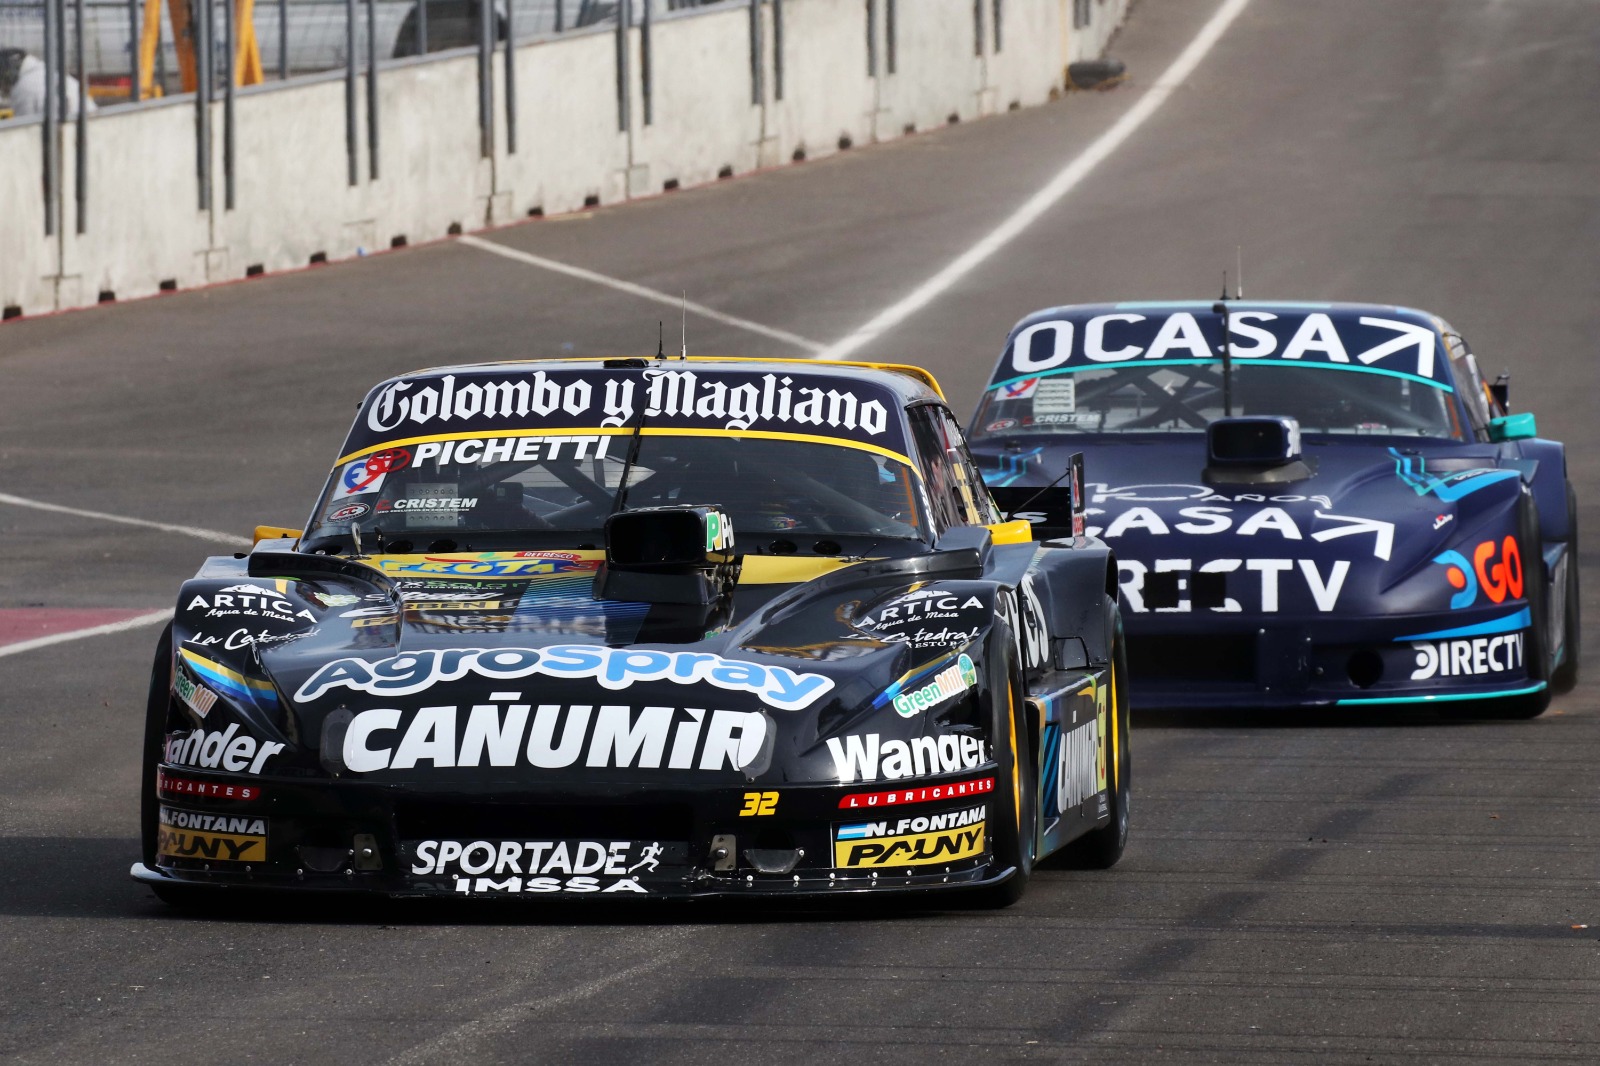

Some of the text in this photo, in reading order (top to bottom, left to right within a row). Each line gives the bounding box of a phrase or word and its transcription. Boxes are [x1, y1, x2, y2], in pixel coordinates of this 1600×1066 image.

[1011, 311, 1350, 374] OCASA
[367, 369, 888, 436] Colombo y Magliano
[411, 435, 612, 468] PICHETTI
[393, 497, 478, 509] CRISTEM
[186, 594, 318, 624] ARTICA
[205, 608, 296, 623] Agua de Mesa
[854, 595, 985, 628] ARTICA
[870, 610, 959, 632] Agua de Mesa
[183, 631, 223, 647] La
[1410, 632, 1524, 681] DIRECTV
[294, 645, 836, 711] AgroSpray
[893, 663, 968, 718] GreenMill
[739, 791, 780, 817] 32
[850, 780, 992, 807] LUBRICANTES
[865, 805, 987, 838] N.FONTANA
[411, 841, 632, 876] SPORTADE
[846, 827, 983, 867] PAUNY
